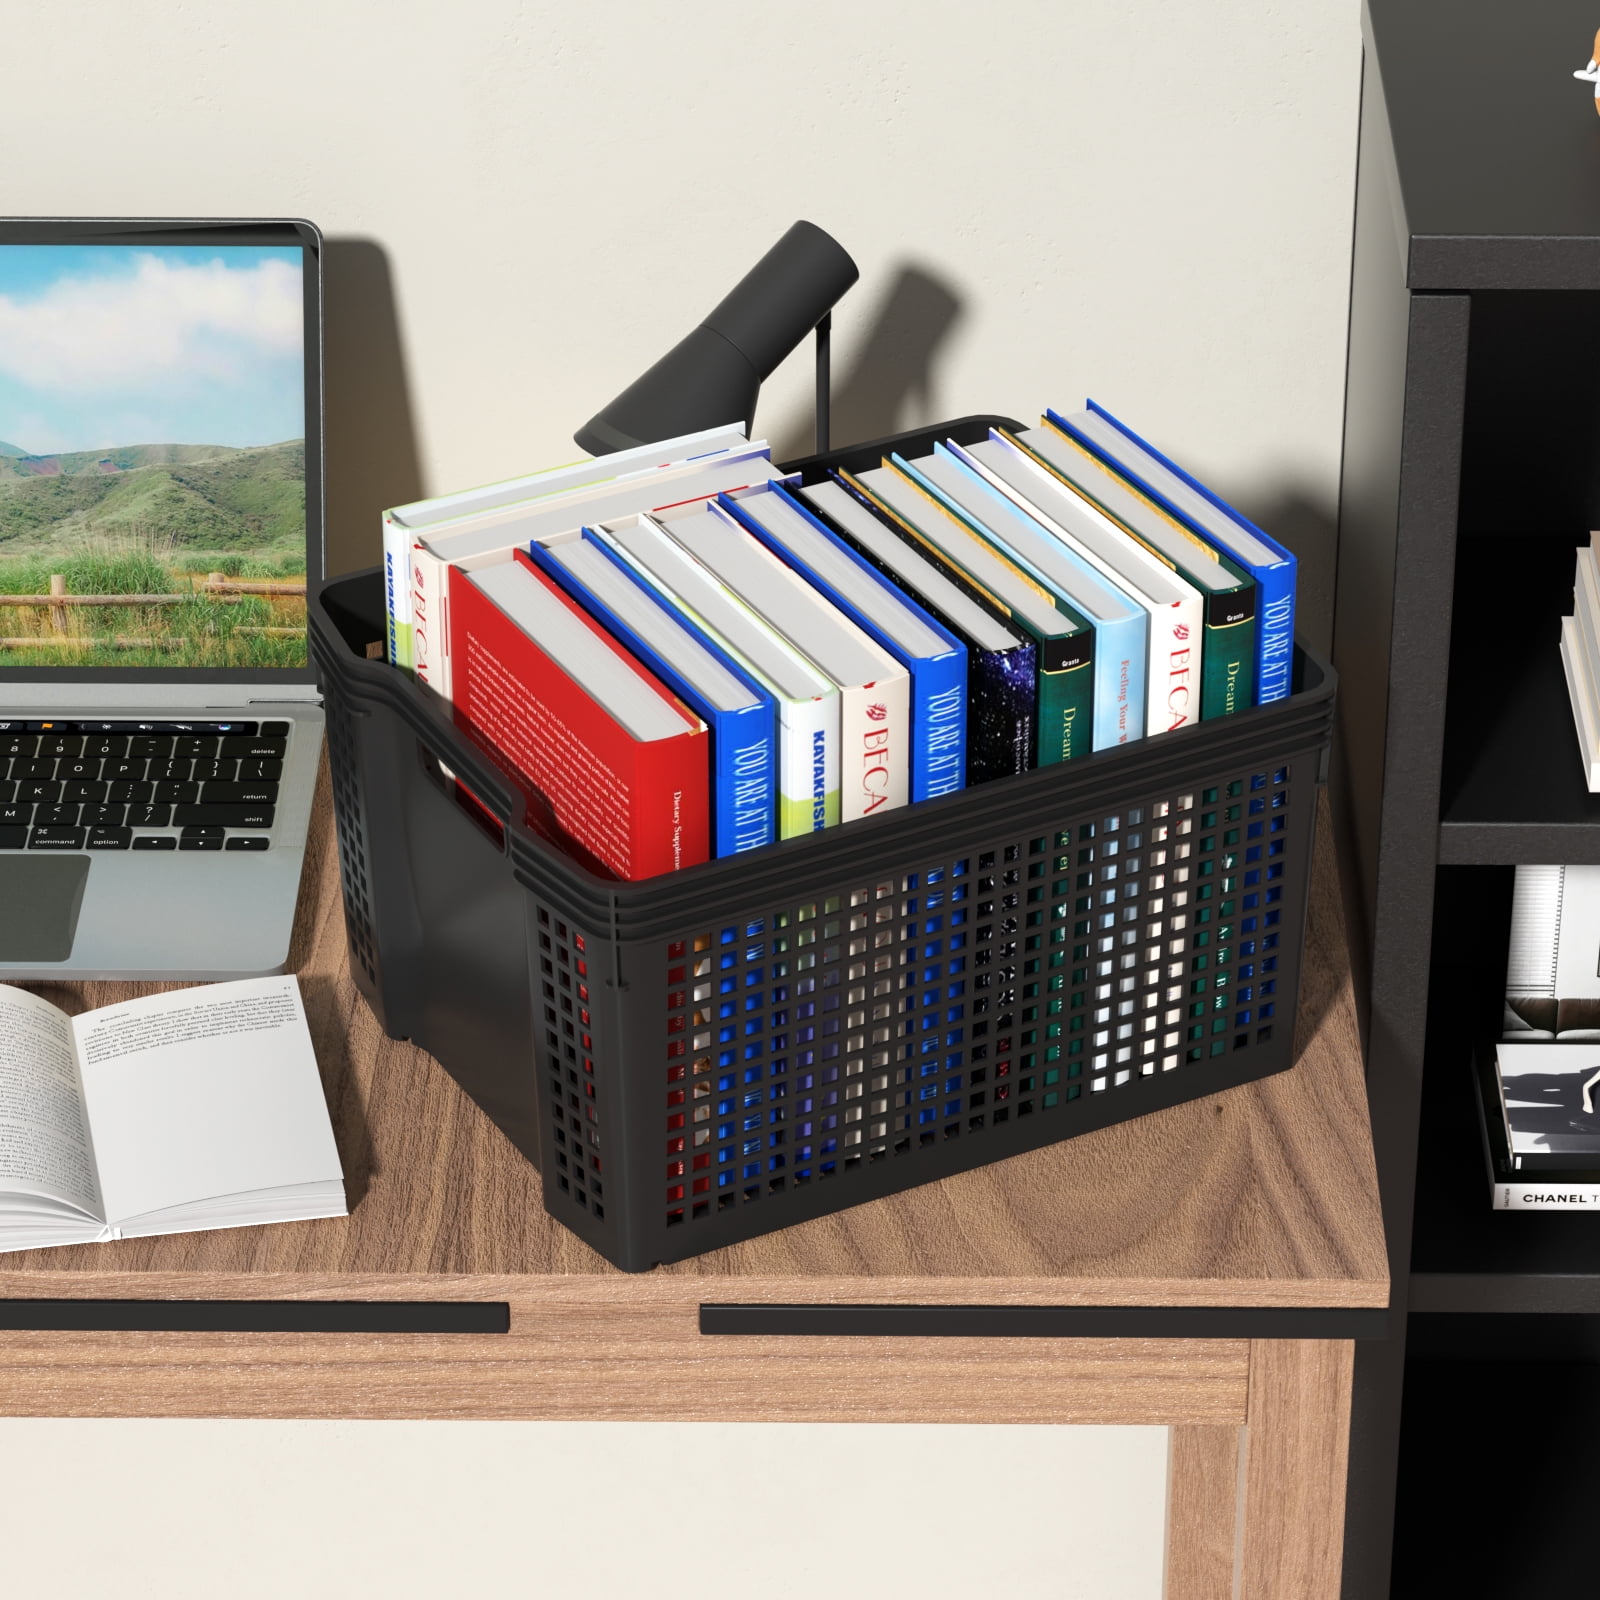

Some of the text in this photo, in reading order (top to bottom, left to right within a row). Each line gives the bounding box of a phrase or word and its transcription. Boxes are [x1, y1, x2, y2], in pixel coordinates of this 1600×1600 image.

[1226, 612, 1244, 622] Granta
[1263, 593, 1292, 630] YOU
[1262, 631, 1289, 660] ARE
[1061, 658, 1080, 667] Granta
[1261, 660, 1288, 679] AT
[1117, 659, 1130, 703] Feeling
[926, 685, 962, 723] YOU
[1118, 703, 1129, 730] Your
[56, 745, 65, 753] 9
[926, 722, 961, 755] ARE
[733, 738, 769, 777] YOU
[927, 752, 961, 773] AT
[863, 727, 889, 815] BECA
[33, 787, 43, 795] K
[81, 787, 87, 795] L
[733, 776, 769, 808] ARE
[672, 791, 683, 825] Dietary
[734, 806, 769, 827] AT
[35, 838, 76, 846] command
[93, 838, 119, 847] option
[1523, 1194, 1587, 1203] CHANEL
